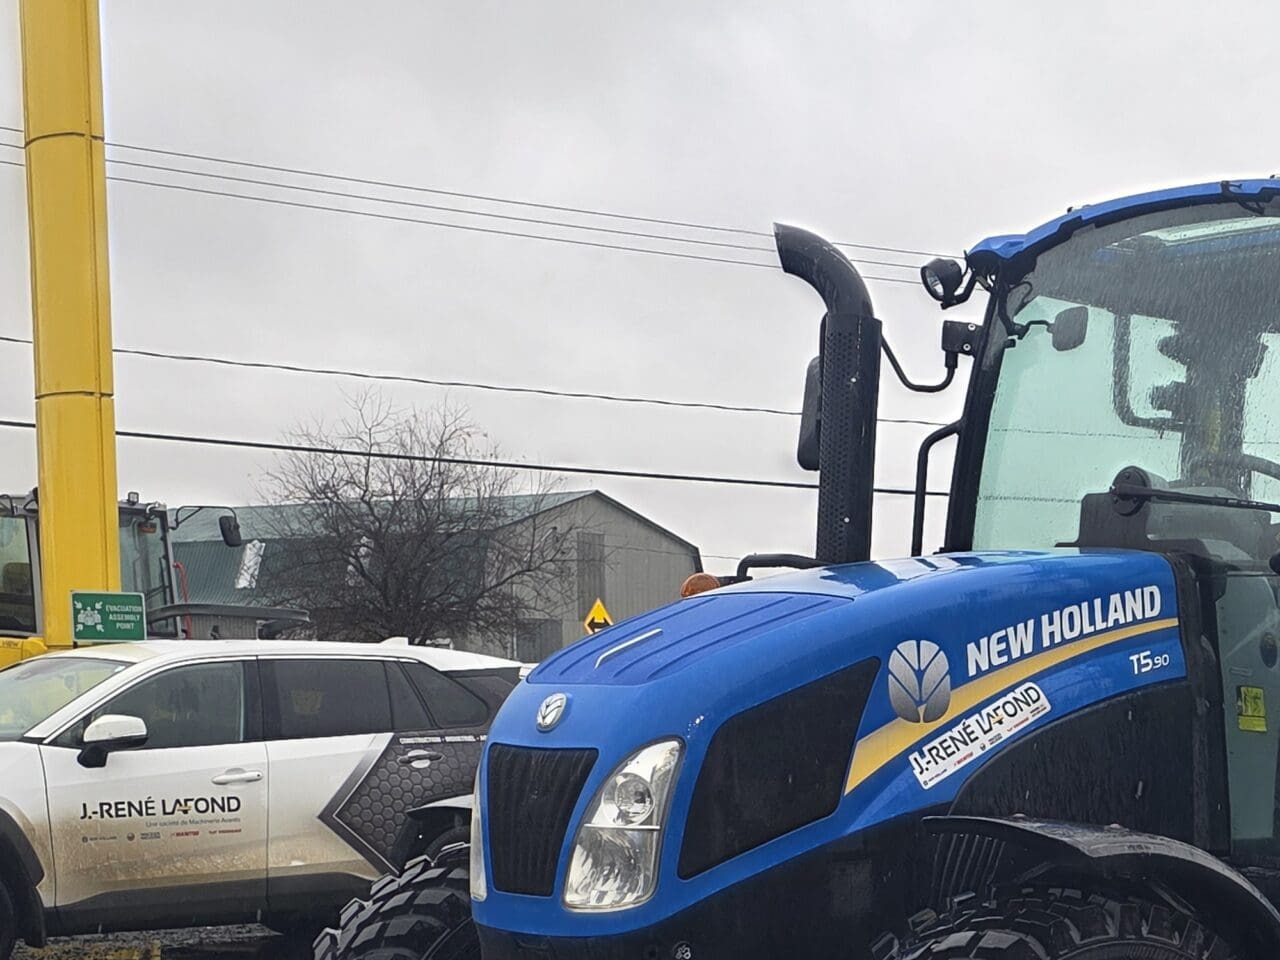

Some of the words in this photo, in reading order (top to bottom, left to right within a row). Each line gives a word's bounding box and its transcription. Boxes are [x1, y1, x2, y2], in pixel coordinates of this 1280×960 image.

[109, 613, 140, 621] ASSEMBLY
[116, 622, 135, 630] POINT
[966, 618, 1034, 677] NEW
[1041, 585, 1161, 647] HOLLAND
[912, 720, 980, 776] J.-RENÉ
[975, 685, 1041, 736] LAFOND
[80, 796, 156, 820] J.-RENÉ
[161, 796, 241, 815] LAFOND
